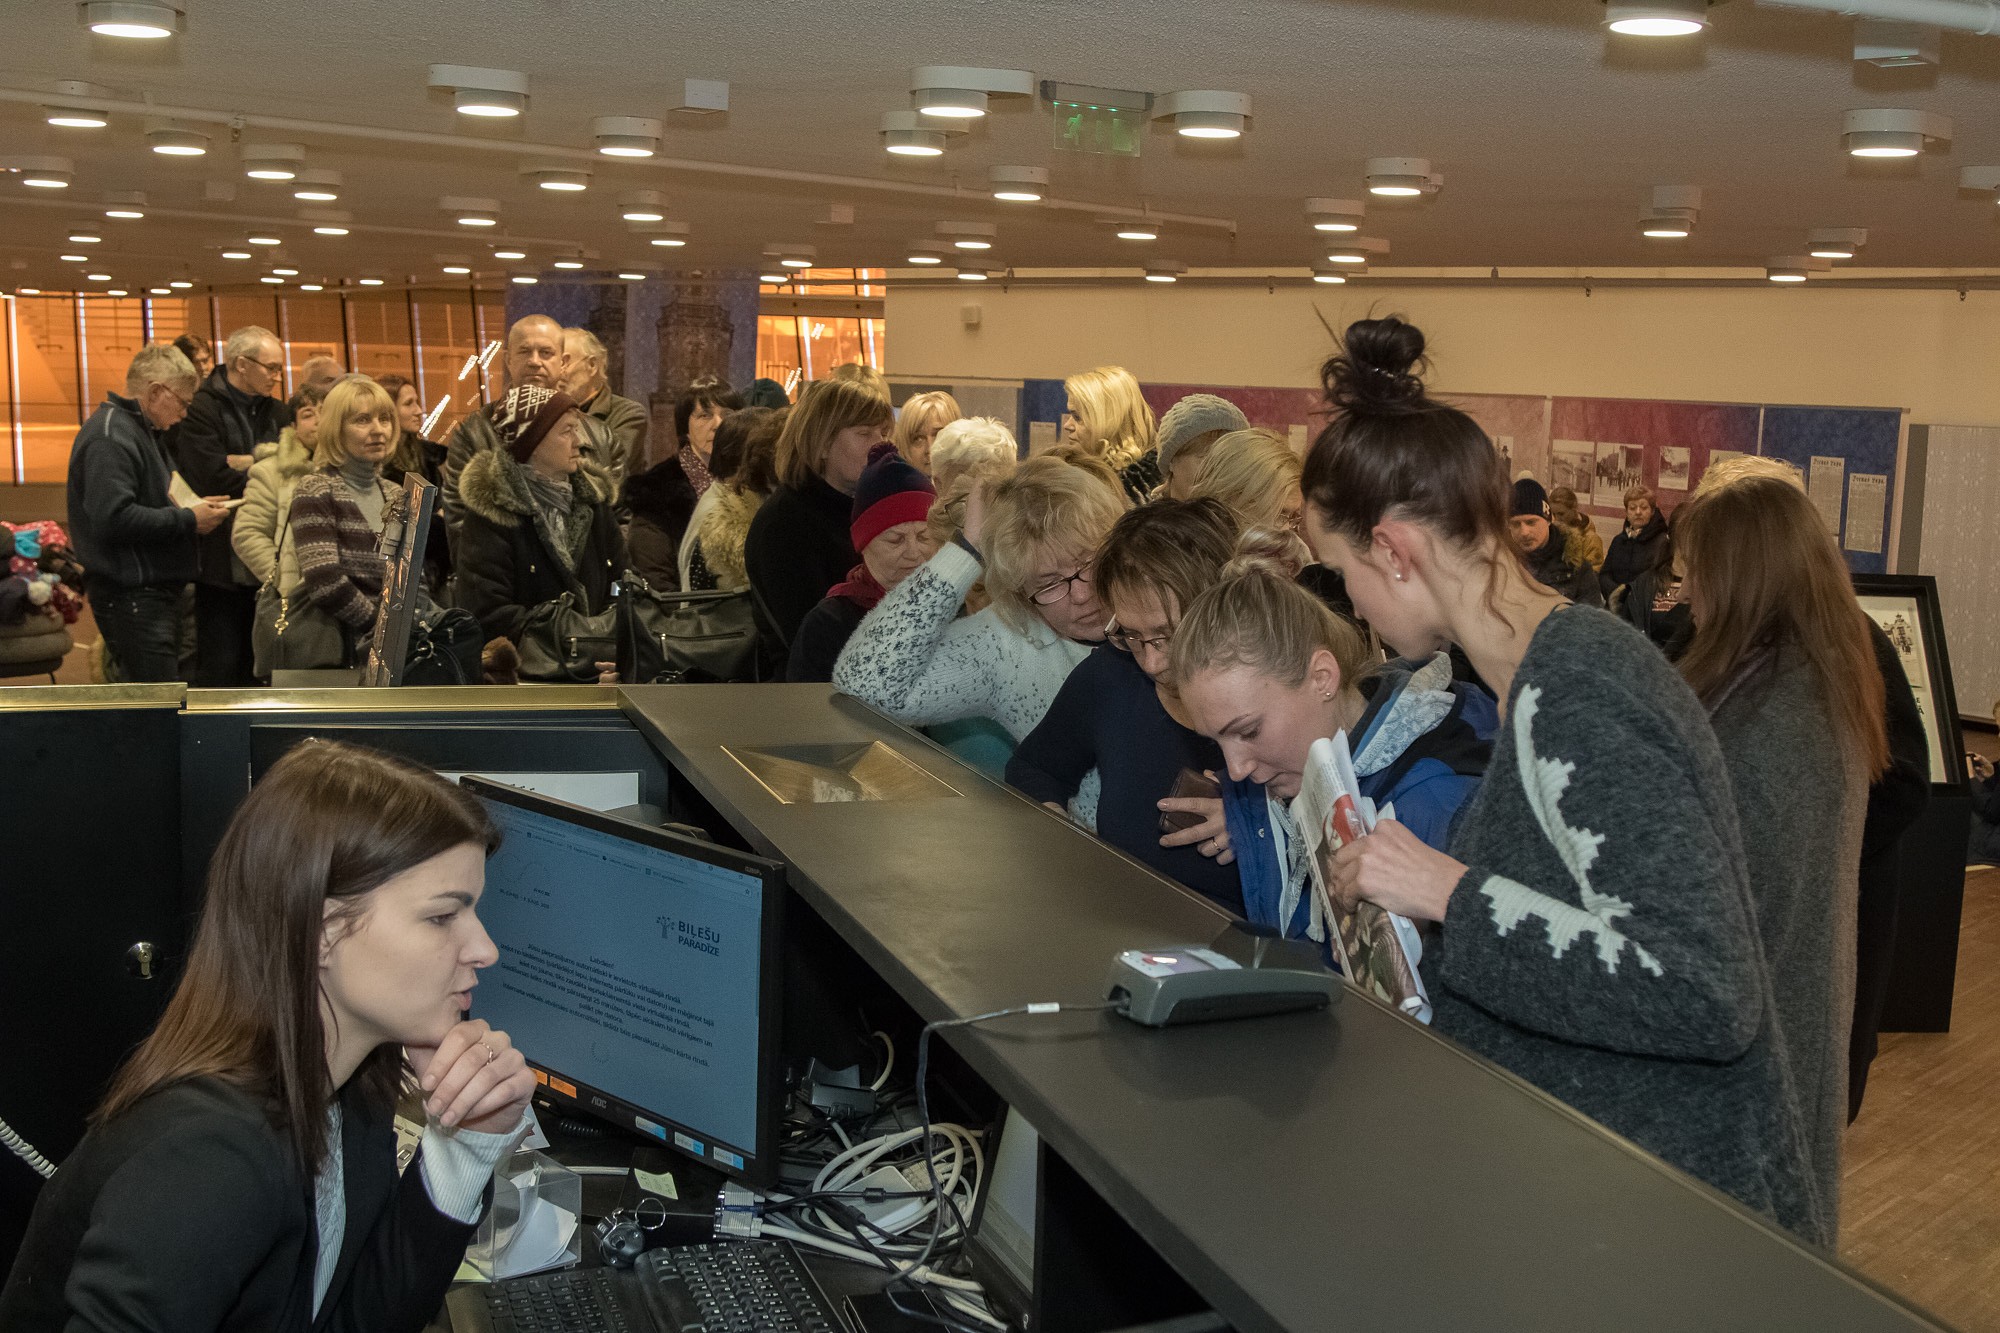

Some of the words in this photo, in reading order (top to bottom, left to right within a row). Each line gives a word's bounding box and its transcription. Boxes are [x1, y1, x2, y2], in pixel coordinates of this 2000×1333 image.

[678, 920, 720, 943] BIĻEŠU
[678, 935, 720, 957] PARADĪZE
[590, 1095, 607, 1108] AOC
